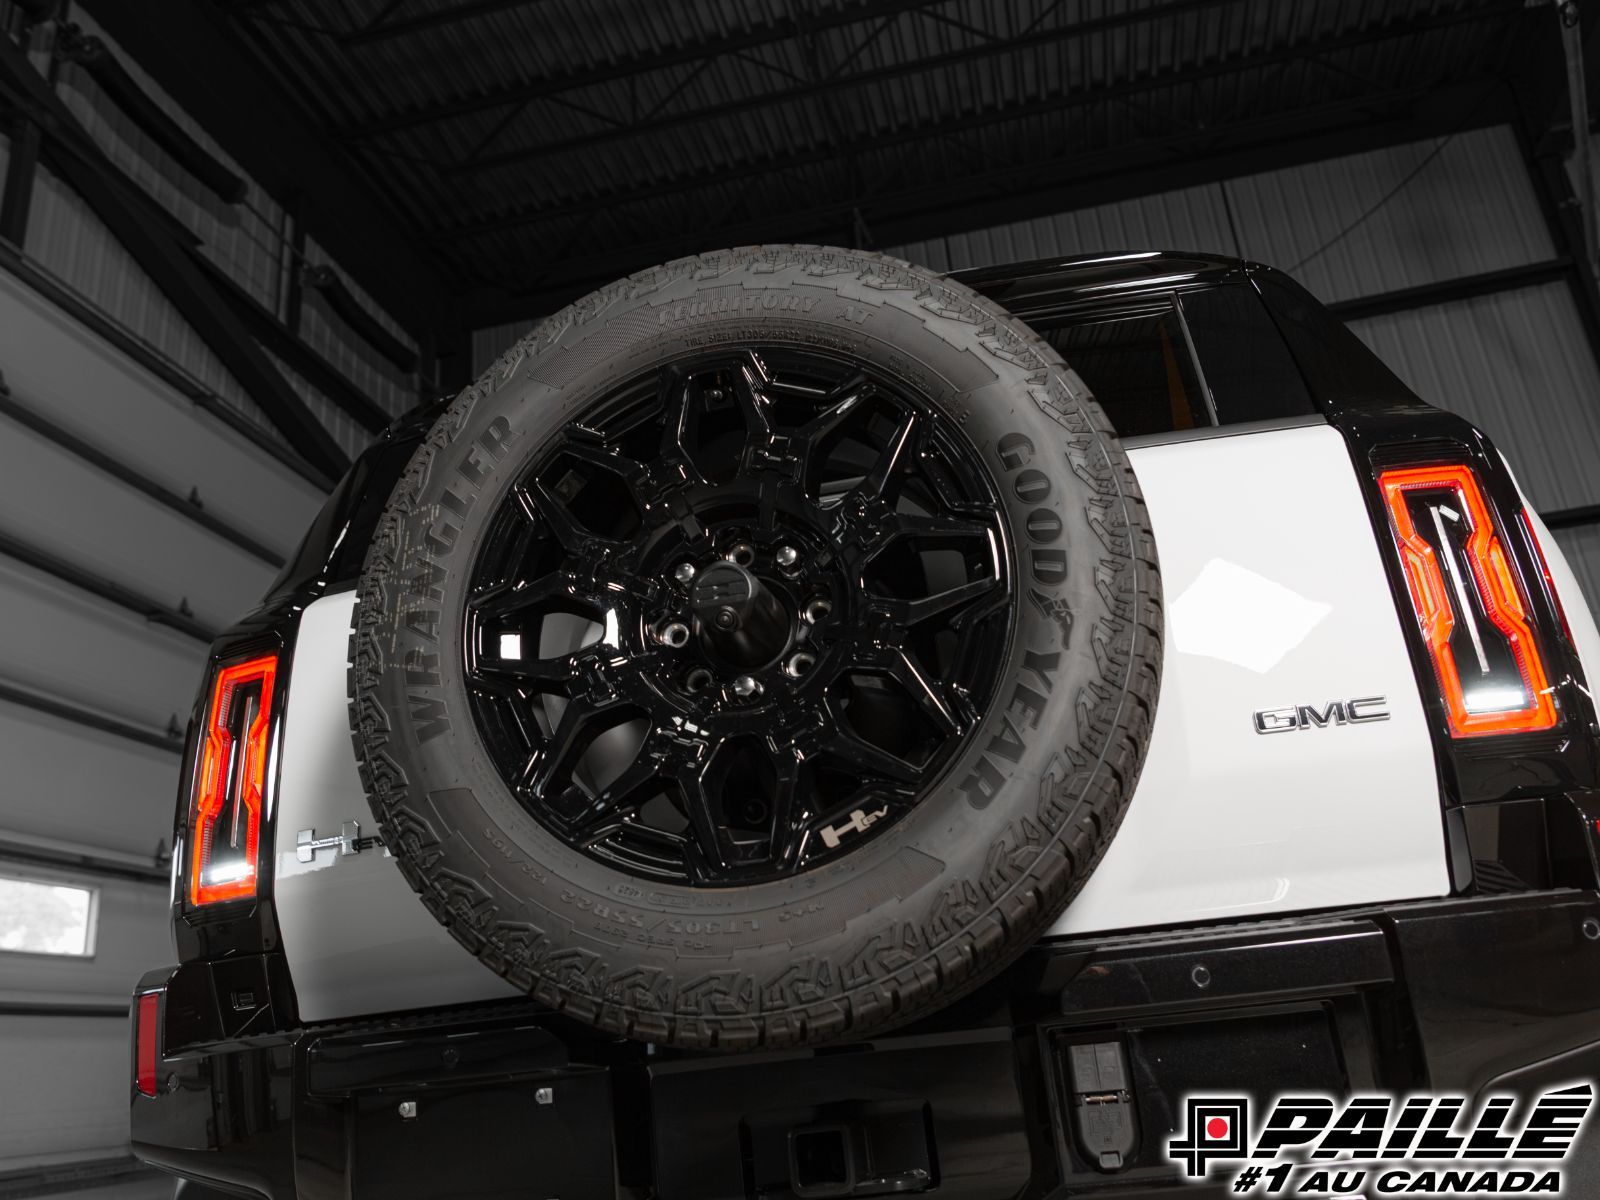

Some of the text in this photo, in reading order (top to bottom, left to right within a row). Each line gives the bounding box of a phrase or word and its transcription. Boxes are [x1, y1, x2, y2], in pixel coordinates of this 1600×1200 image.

[658, 295, 821, 326] TERRITORY
[403, 415, 521, 746] WRANGLER
[1253, 695, 1391, 735] GMC
